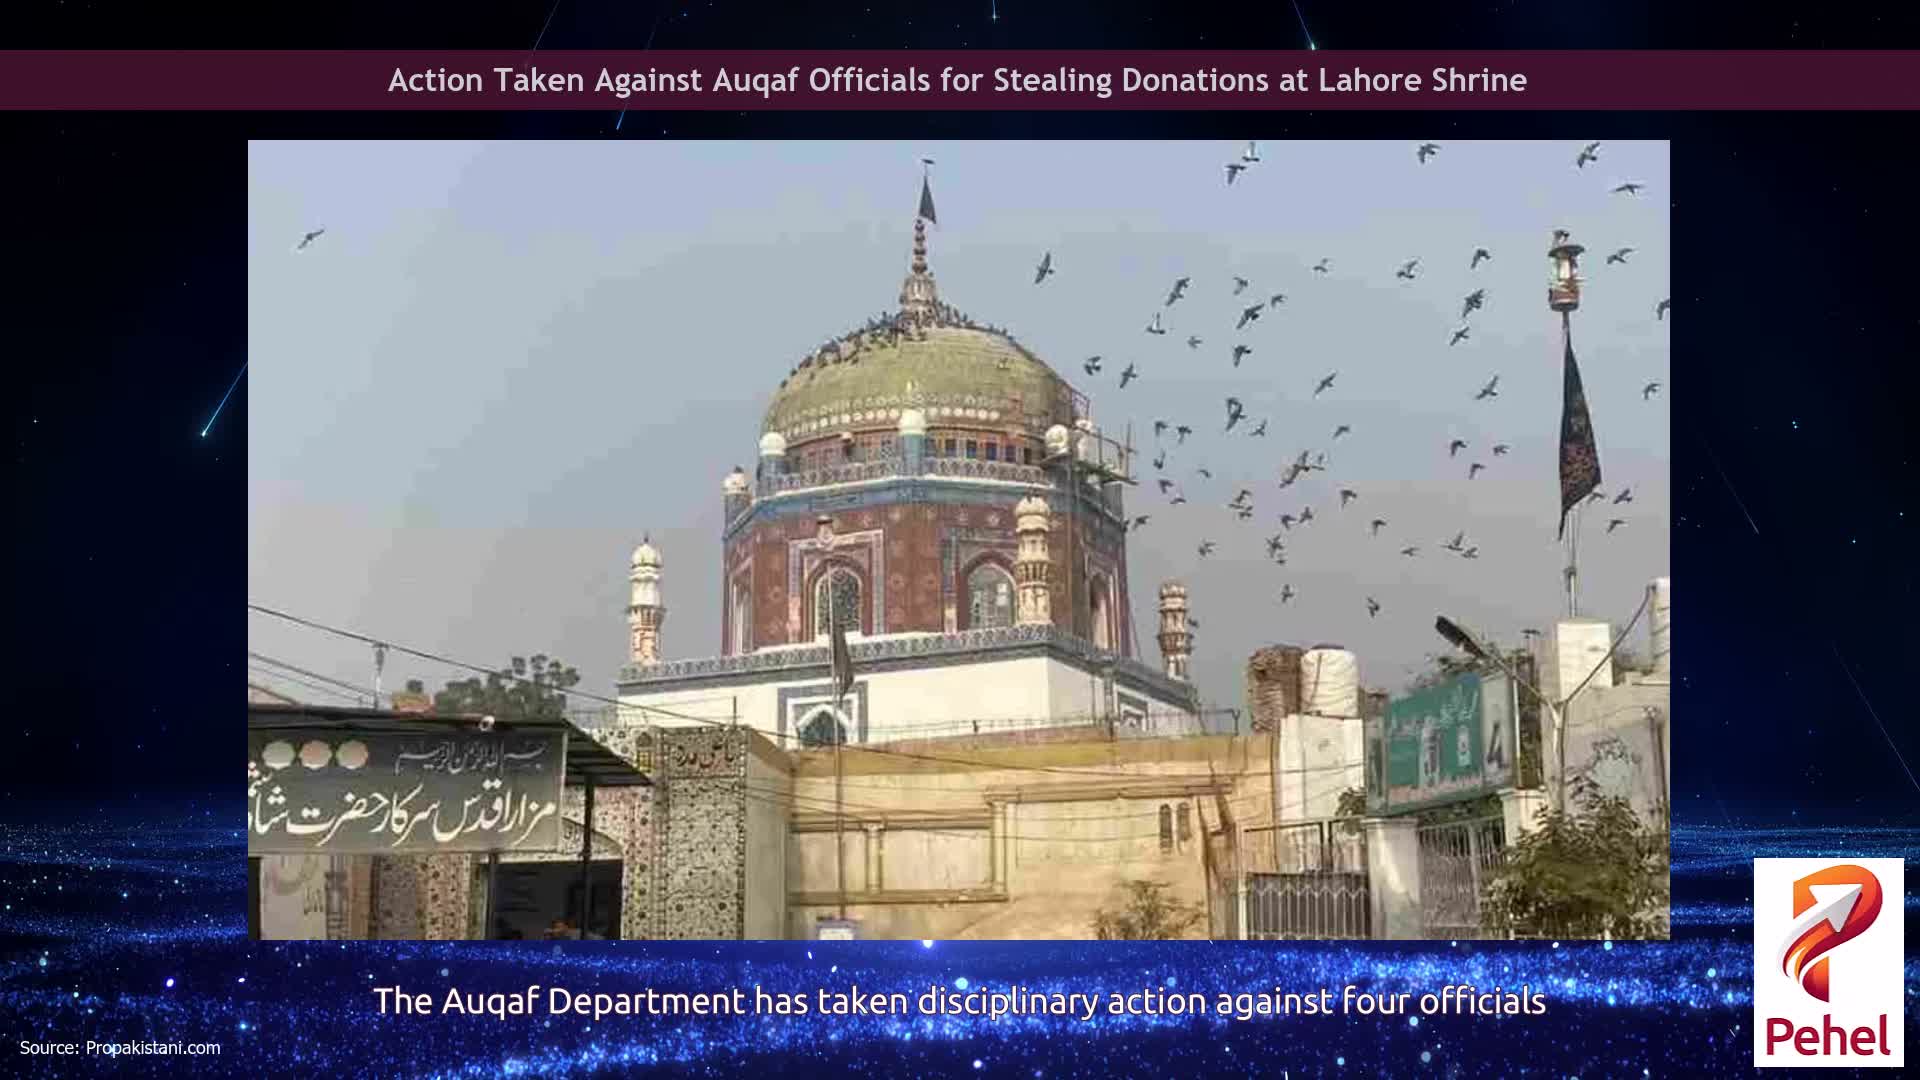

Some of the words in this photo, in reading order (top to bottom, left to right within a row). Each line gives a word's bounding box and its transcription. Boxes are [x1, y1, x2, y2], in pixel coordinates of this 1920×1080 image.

[286, 791, 391, 847] حضرت
[433, 778, 513, 843] اقدس
[498, 790, 557, 846] مزار
